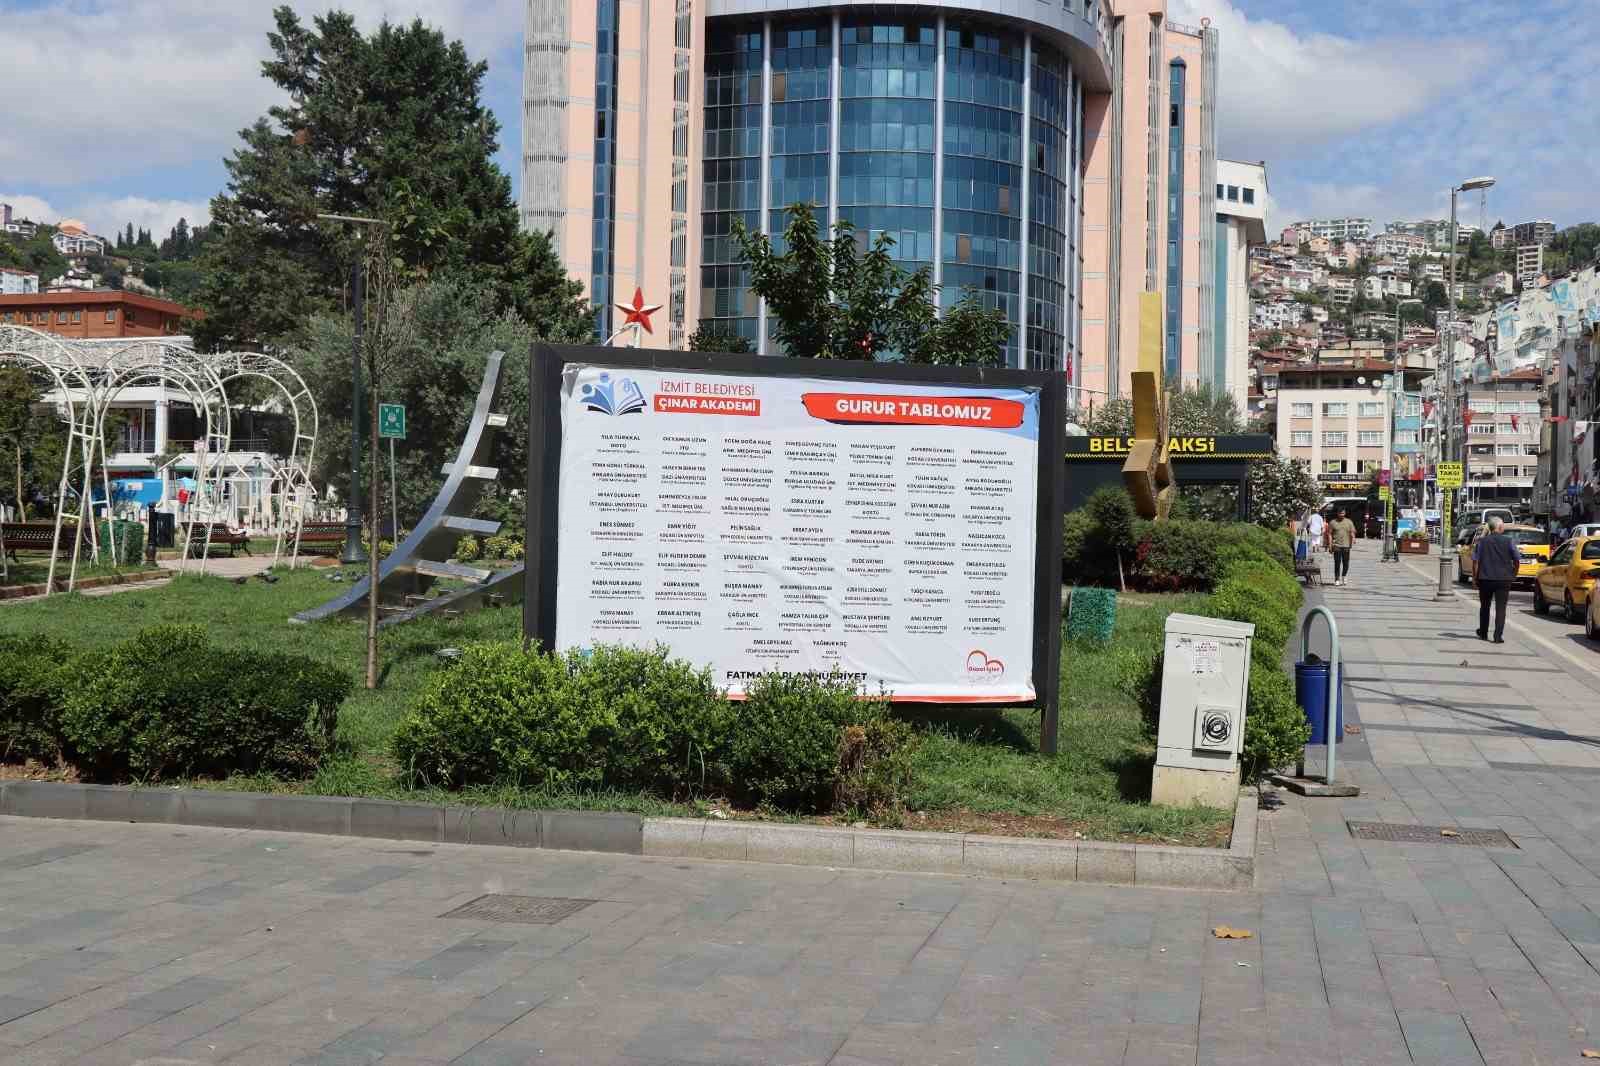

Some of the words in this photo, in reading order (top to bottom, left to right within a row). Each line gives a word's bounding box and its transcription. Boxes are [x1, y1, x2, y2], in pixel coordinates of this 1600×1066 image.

[661, 380, 691, 392] İZMİT
[695, 383, 754, 396] BELEDİYESİ
[658, 398, 698, 410] ÇINAR
[700, 400, 756, 411] AKADEMİ
[836, 399, 896, 415] GURUR
[899, 402, 992, 420] TABLOMUZ
[1089, 438, 1137, 452] BELS
[726, 671, 762, 680] FATMA
